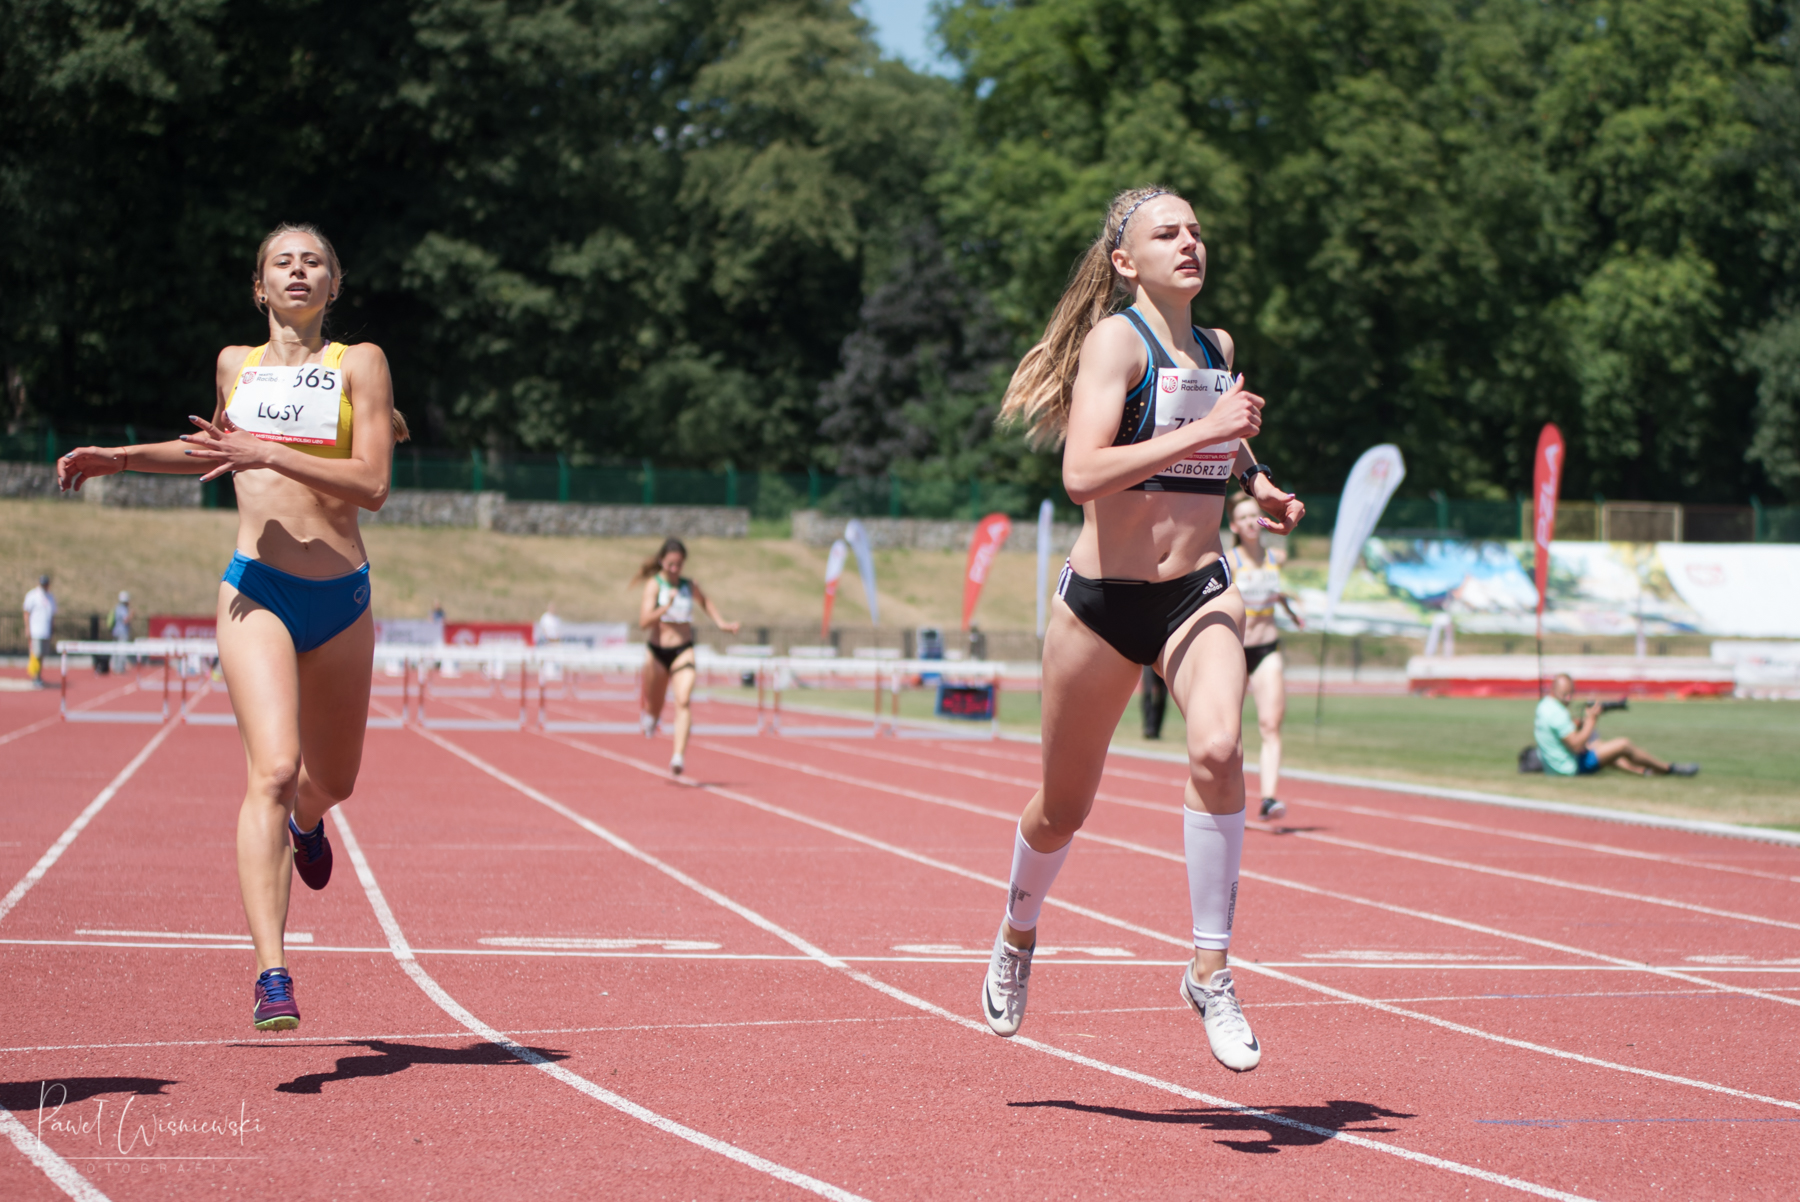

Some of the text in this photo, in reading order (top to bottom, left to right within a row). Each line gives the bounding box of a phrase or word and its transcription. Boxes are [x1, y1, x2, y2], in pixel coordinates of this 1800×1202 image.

[1181, 384, 1208, 392] Racibórz
[1161, 462, 1216, 476] ACIBÓRZ
[1537, 443, 1561, 551] PZLA
[1202, 583, 1224, 595] adidas
